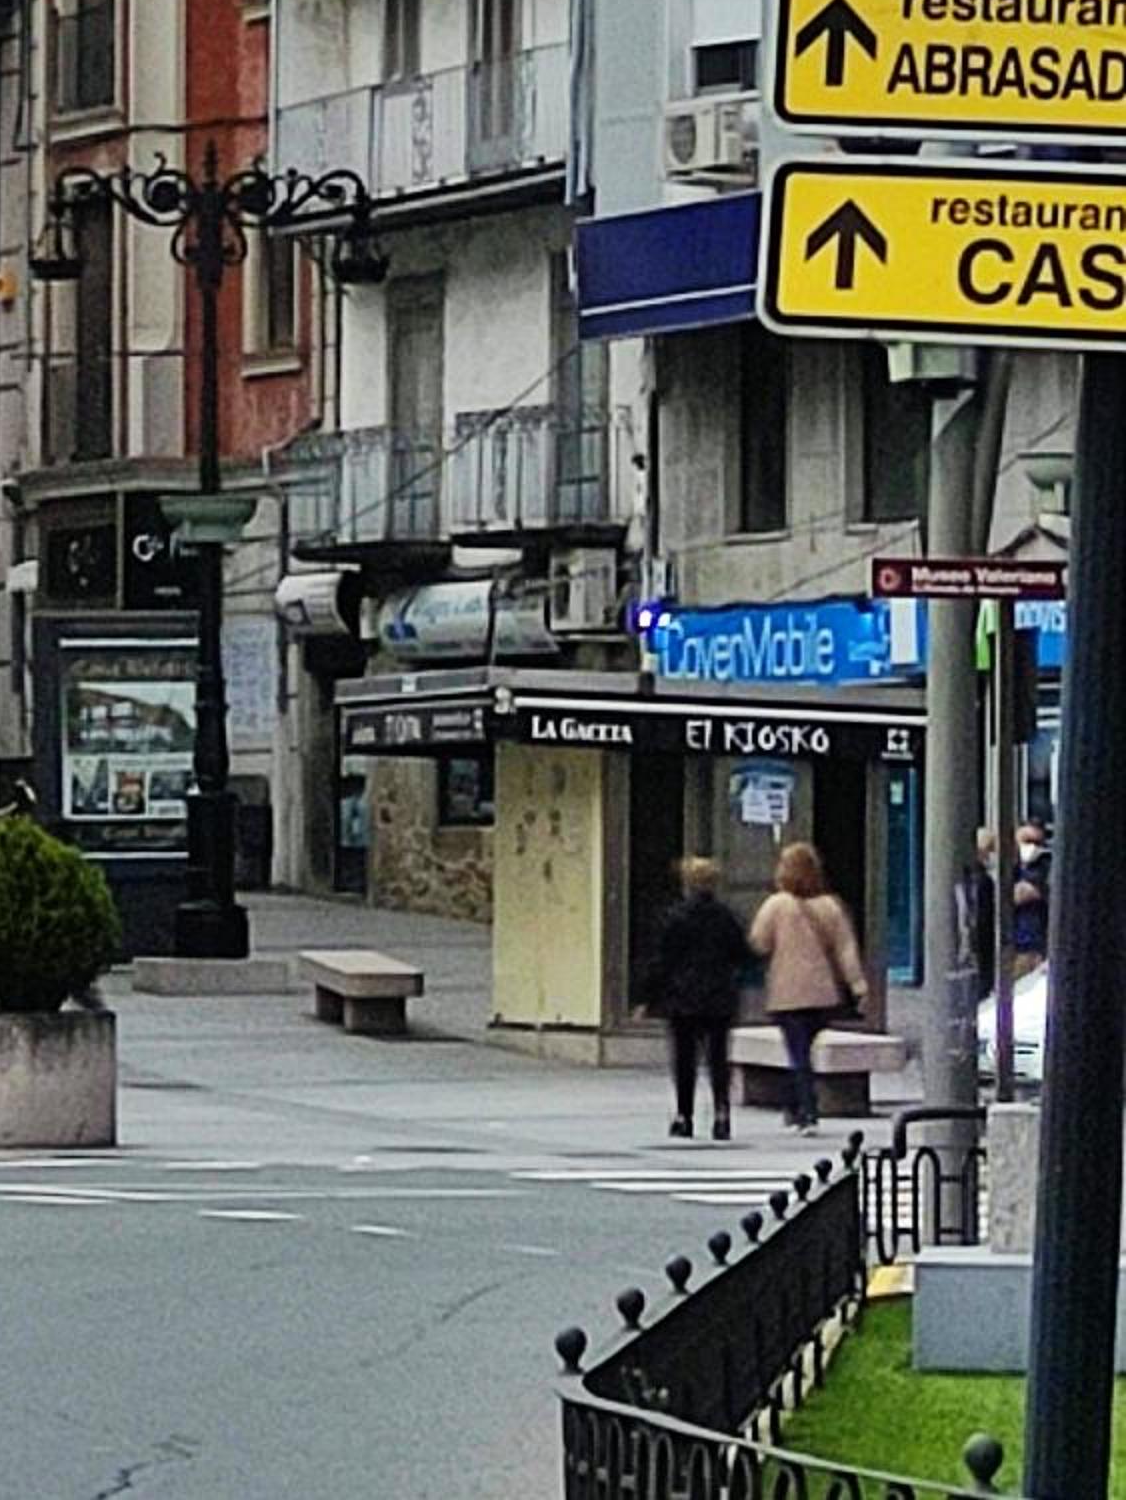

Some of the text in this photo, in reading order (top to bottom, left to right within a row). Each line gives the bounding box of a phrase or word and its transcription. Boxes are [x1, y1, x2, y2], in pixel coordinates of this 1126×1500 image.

[886, 42, 1126, 101] ABRASAD
[931, 194, 1126, 232] restauran
[958, 238, 1126, 311] CAS
[724, 722, 830, 754] KIOSKO
